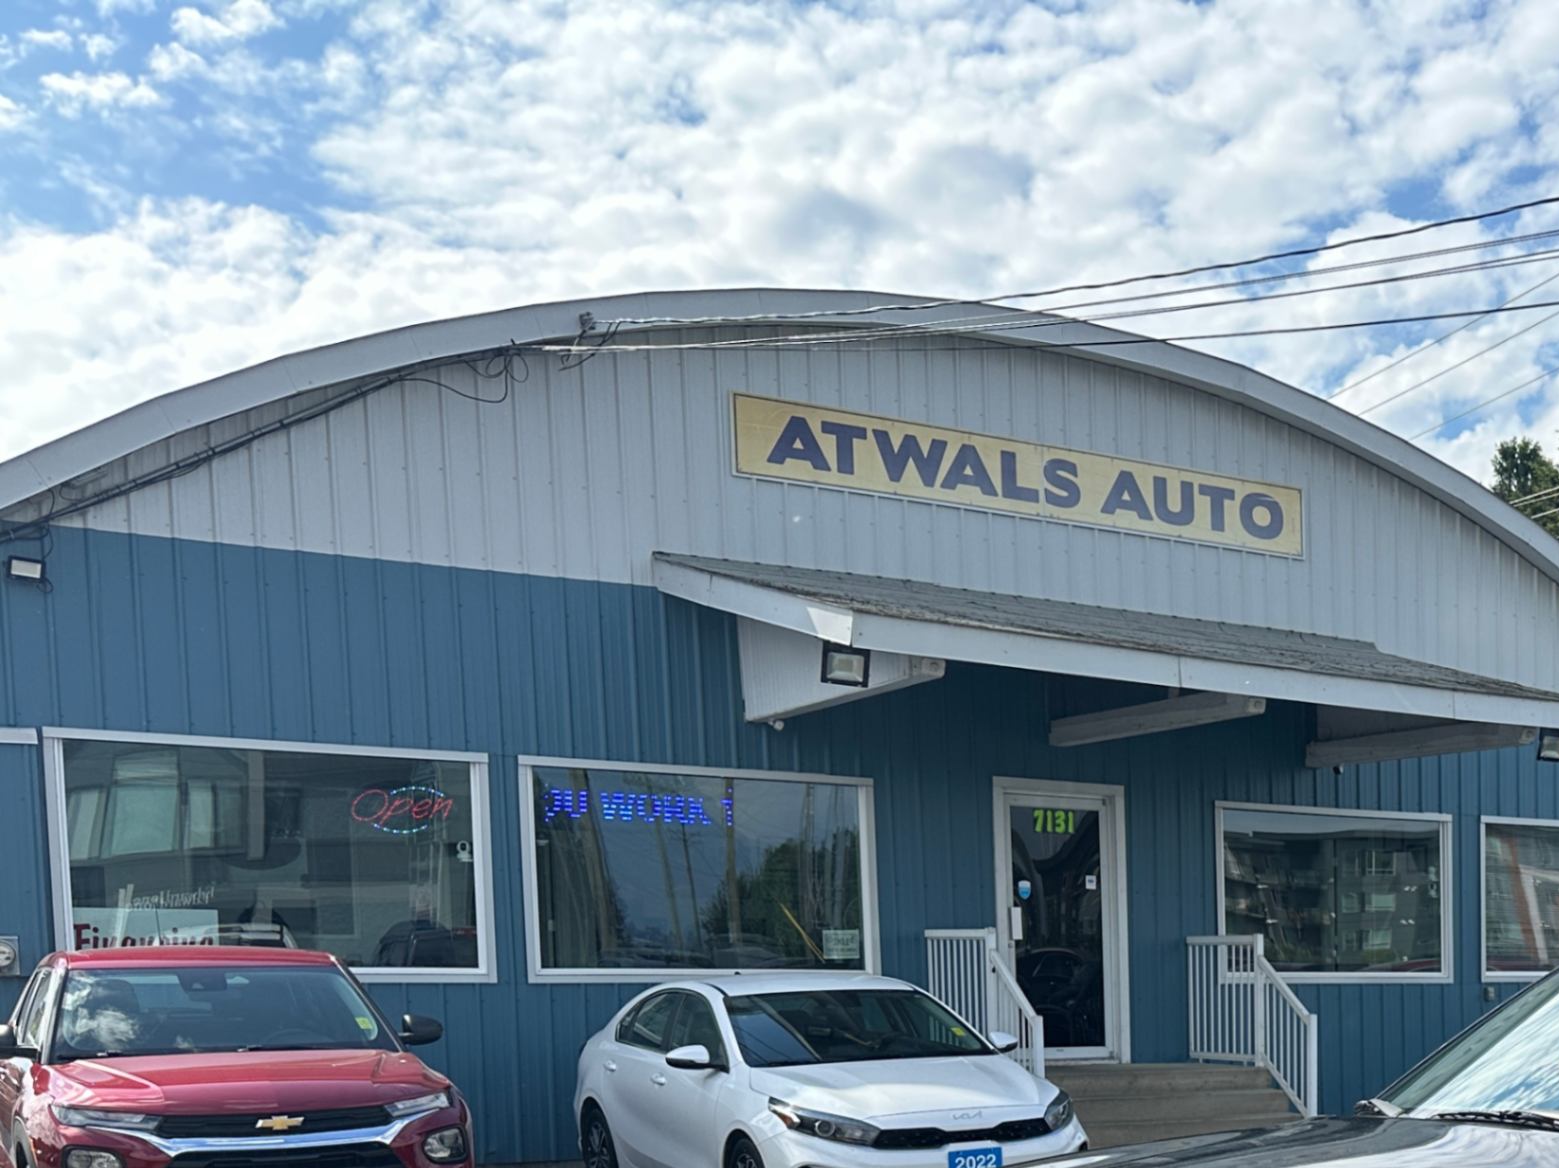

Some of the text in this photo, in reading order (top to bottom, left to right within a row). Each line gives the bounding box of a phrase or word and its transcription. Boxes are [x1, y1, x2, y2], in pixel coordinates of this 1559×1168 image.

[766, 416, 1284, 539] ATWALS AUTO
[352, 789, 454, 827] Open
[1034, 810, 1075, 833] 7131
